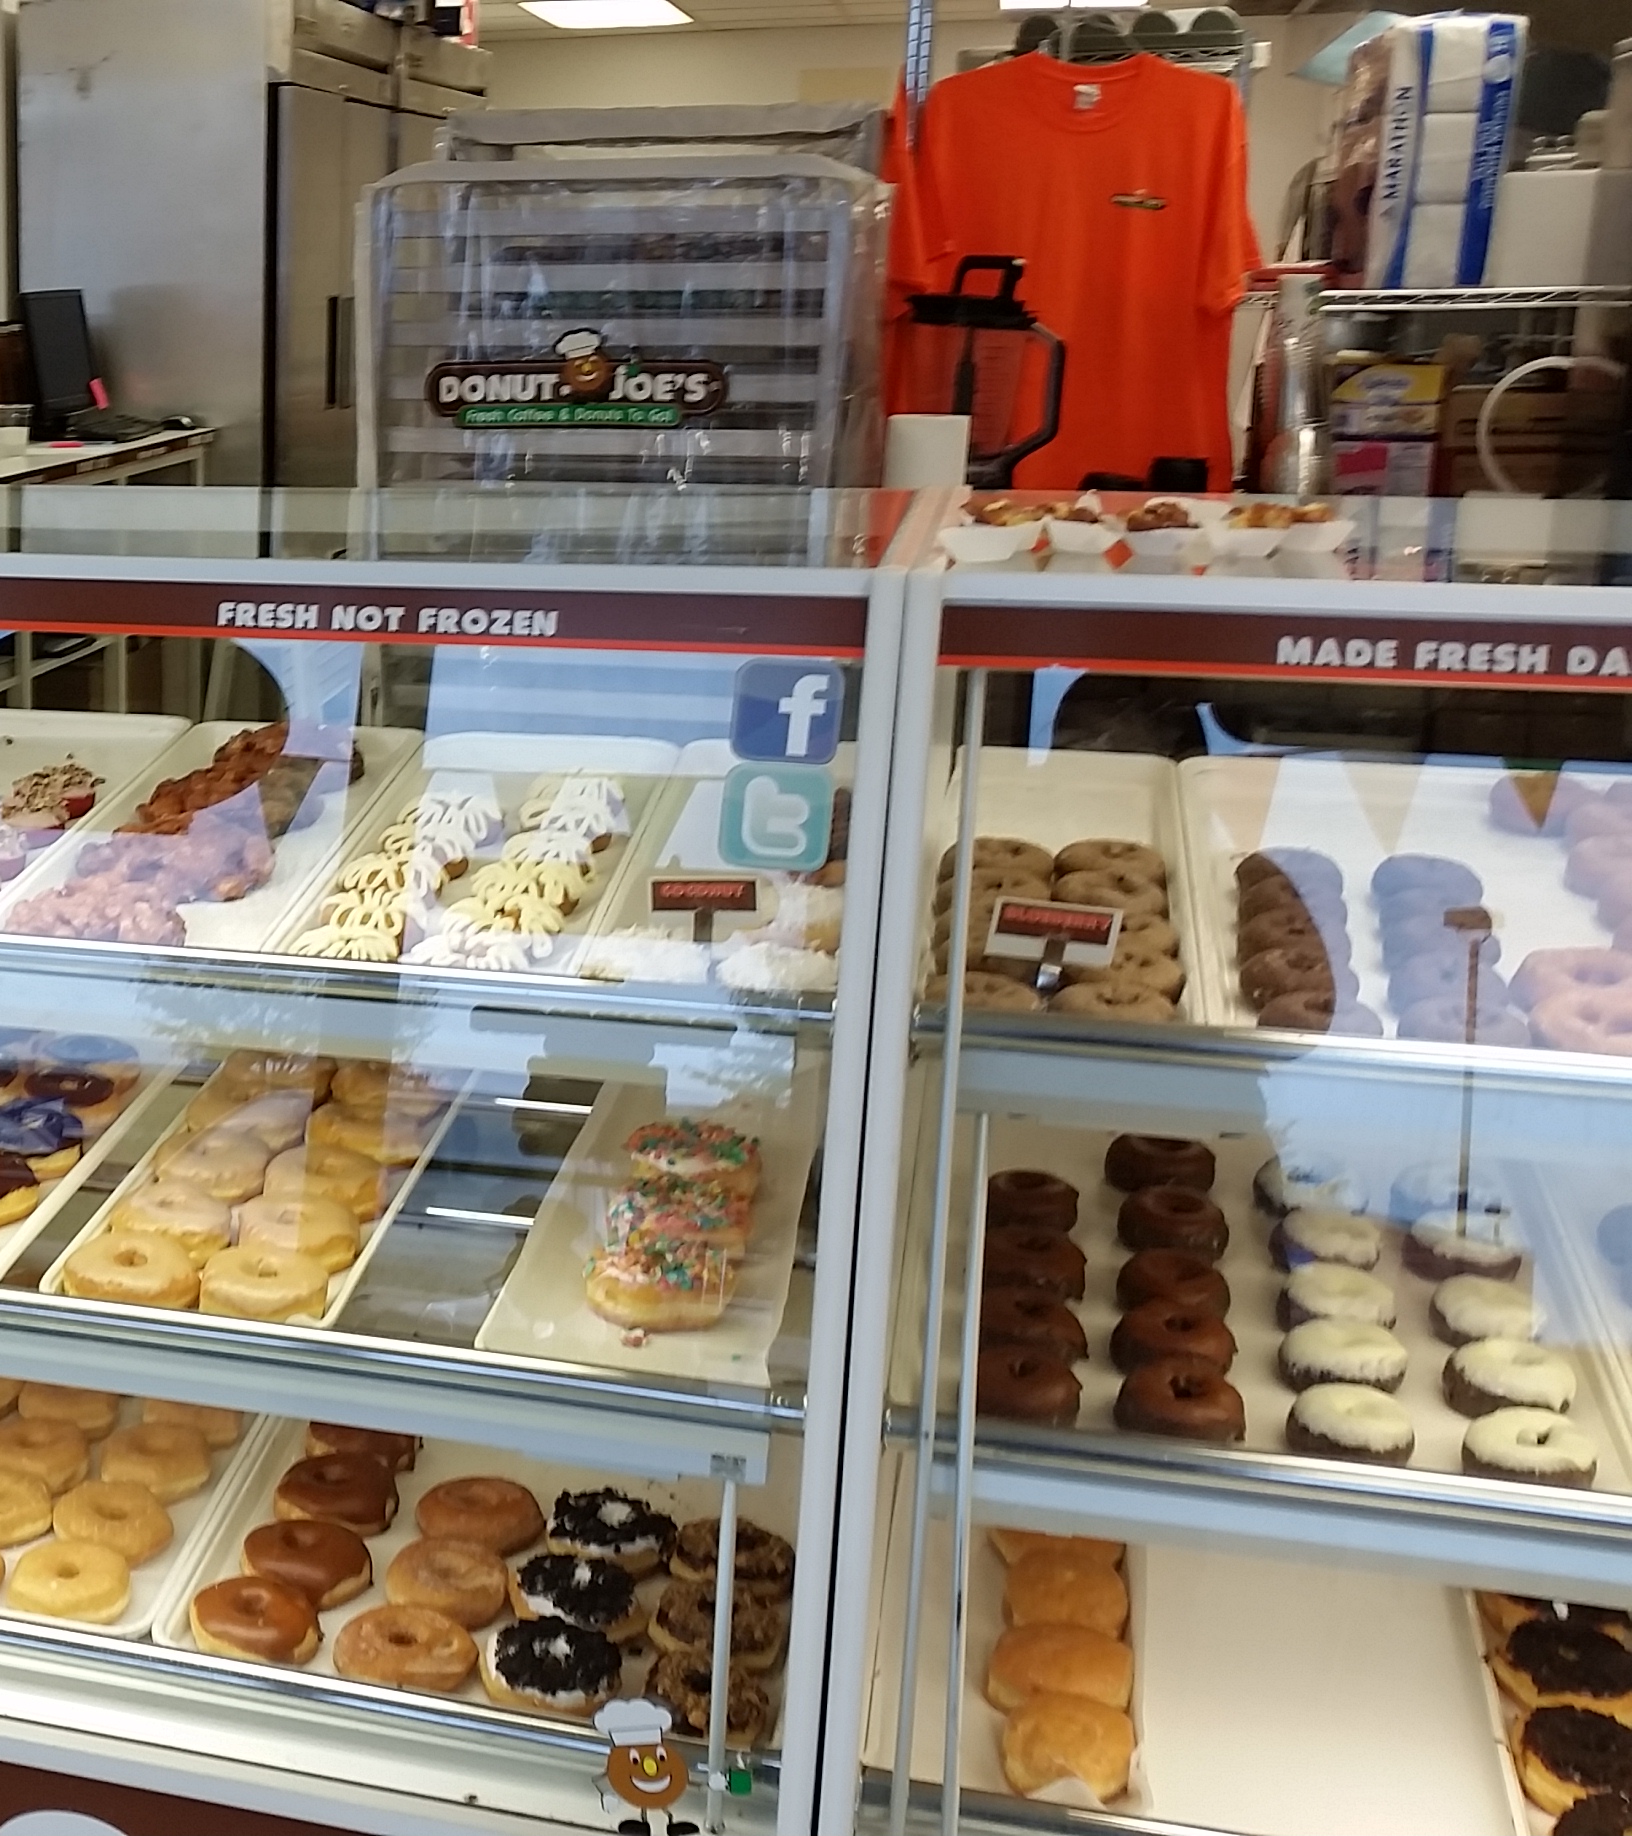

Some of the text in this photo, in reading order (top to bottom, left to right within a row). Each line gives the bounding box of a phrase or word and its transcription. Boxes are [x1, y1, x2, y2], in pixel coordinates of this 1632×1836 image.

[438, 364, 710, 403] DONUT JOE'S
[217, 601, 560, 637] FRESH NOT FROZEN
[1276, 635, 1399, 668] MADE
[1414, 639, 1551, 675] FRESH
[660, 882, 746, 898] COCONUT
